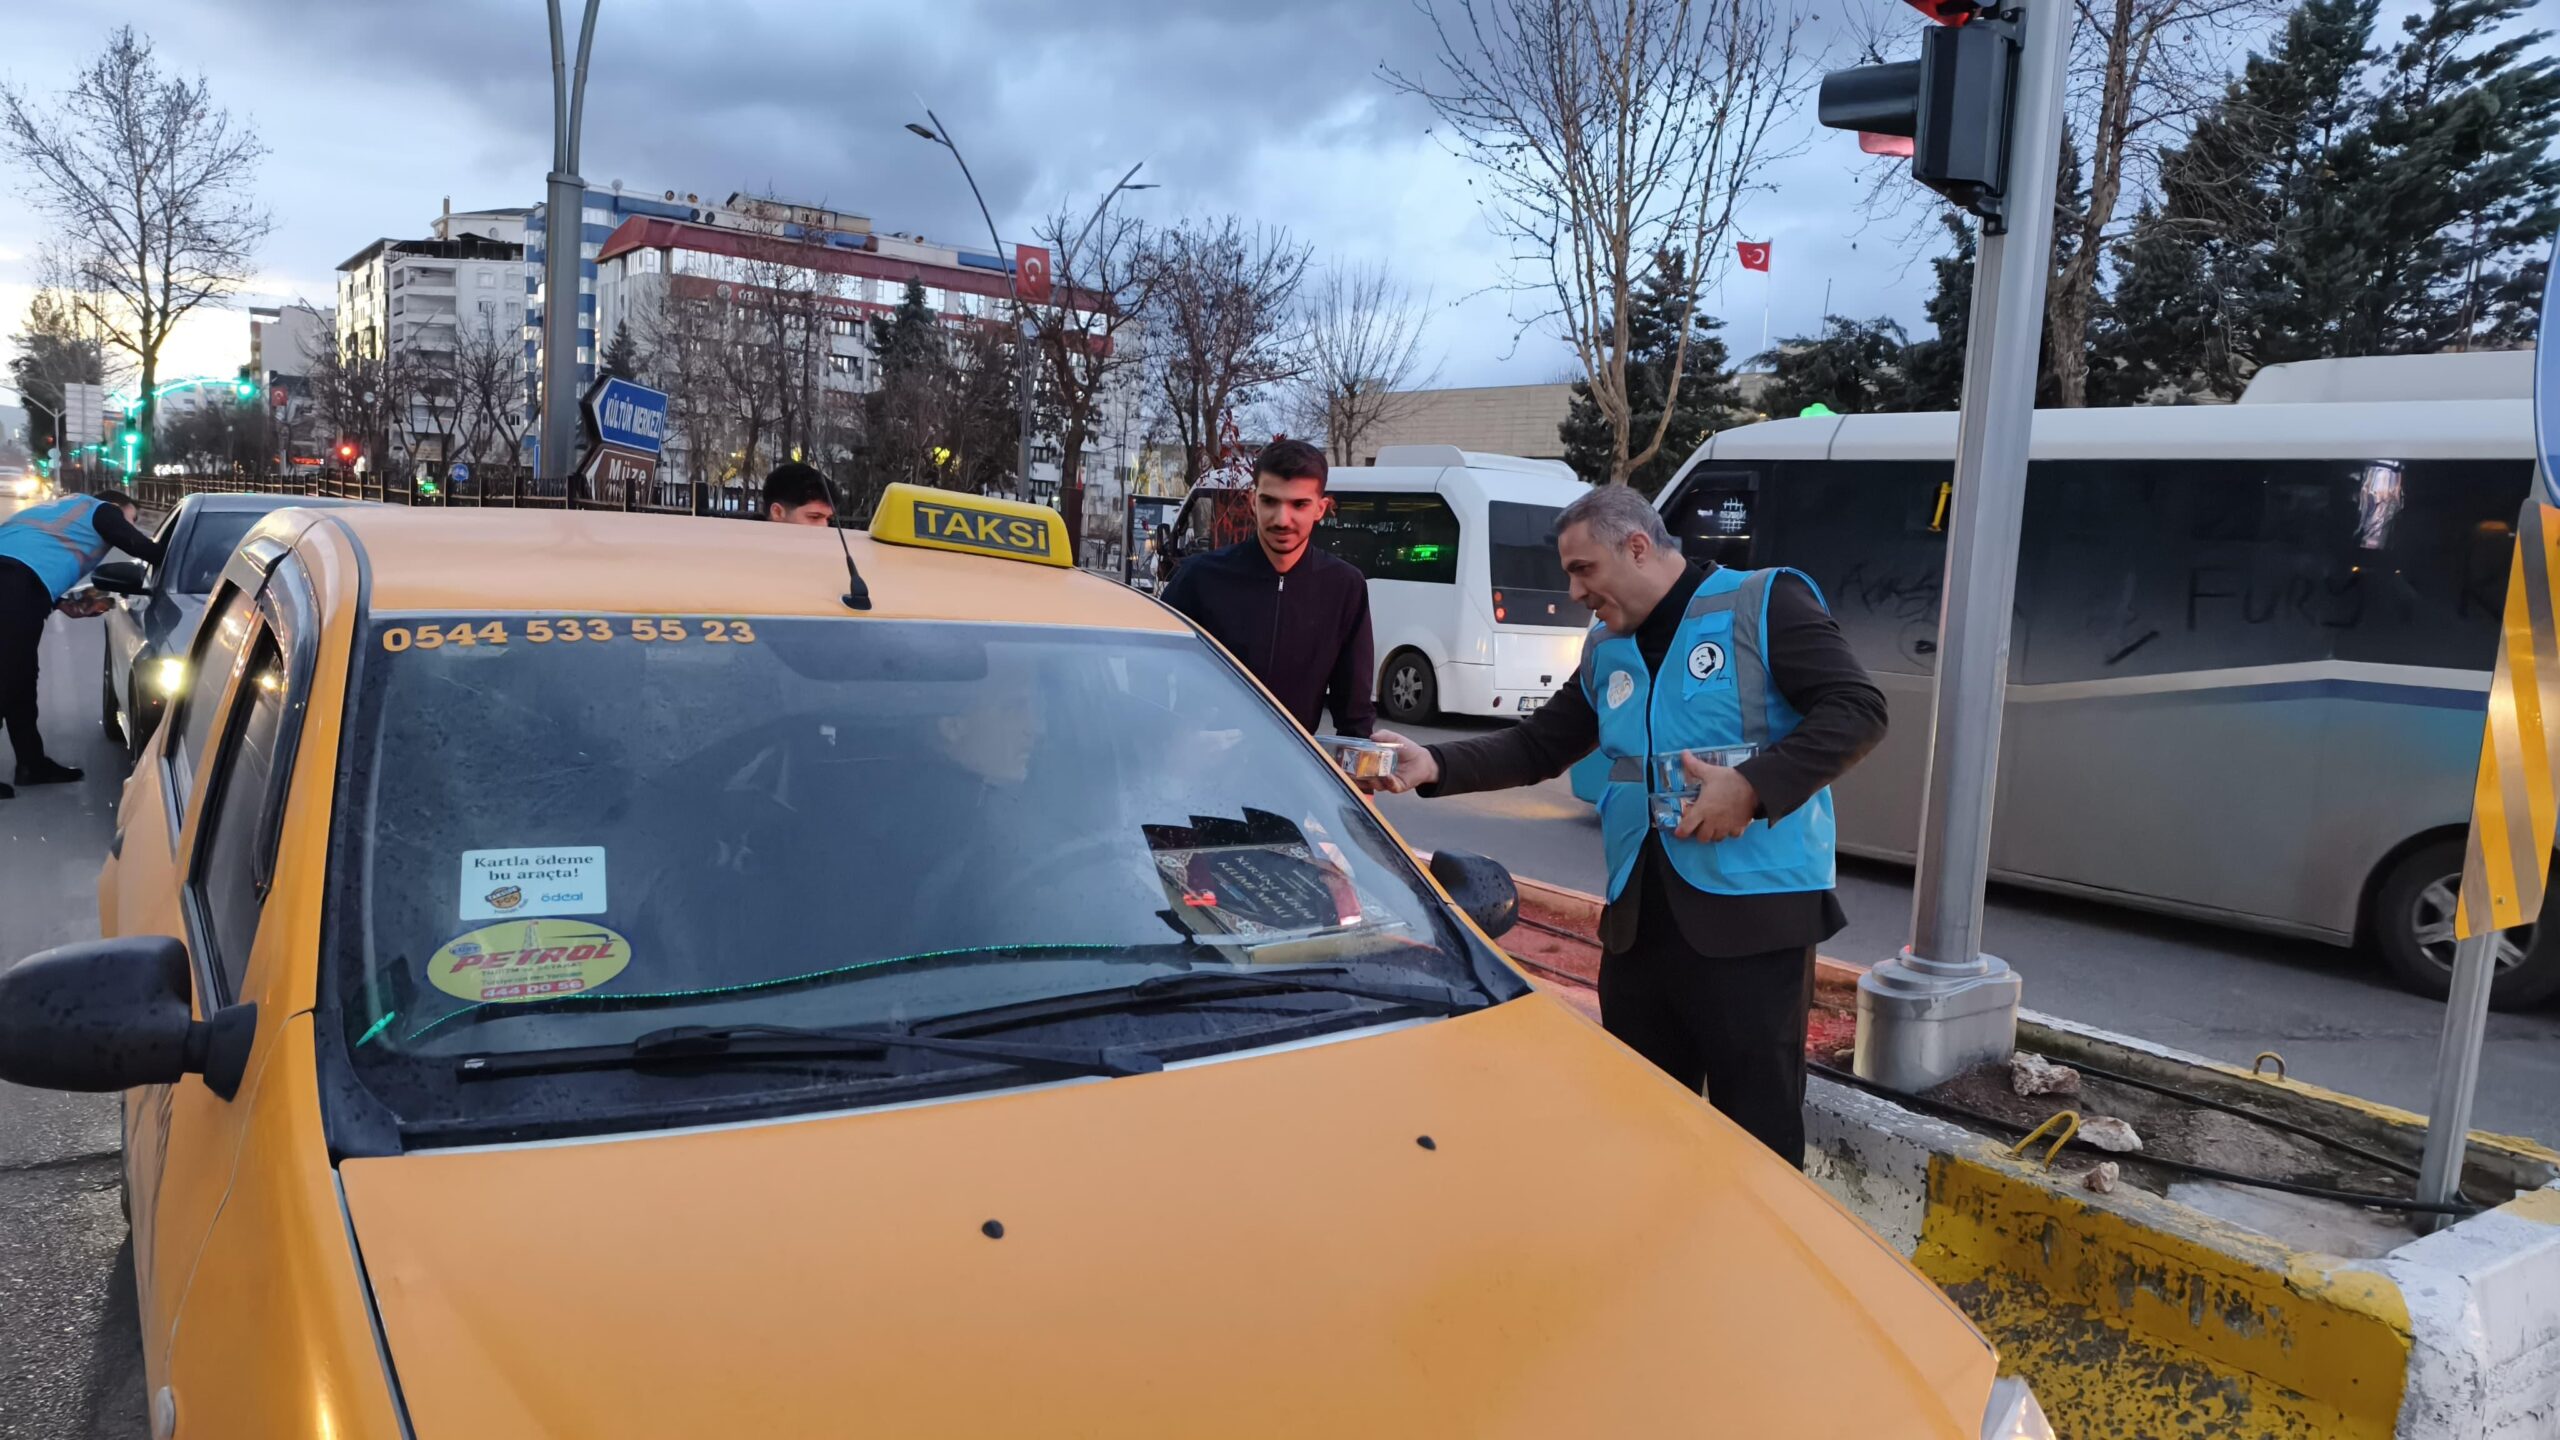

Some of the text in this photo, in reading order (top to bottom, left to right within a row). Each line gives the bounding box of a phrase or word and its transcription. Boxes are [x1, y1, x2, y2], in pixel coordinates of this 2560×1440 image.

[603, 393, 664, 439] KÜLTÜR MERKEZİ
[608, 458, 647, 485] Müze
[382, 619, 756, 652] 0544 533 55 23
[474, 854, 593, 868] Kartla ödeme
[489, 868, 579, 881] bu araçta!
[449, 943, 616, 974] PETROL
[484, 986, 520, 998] 444
